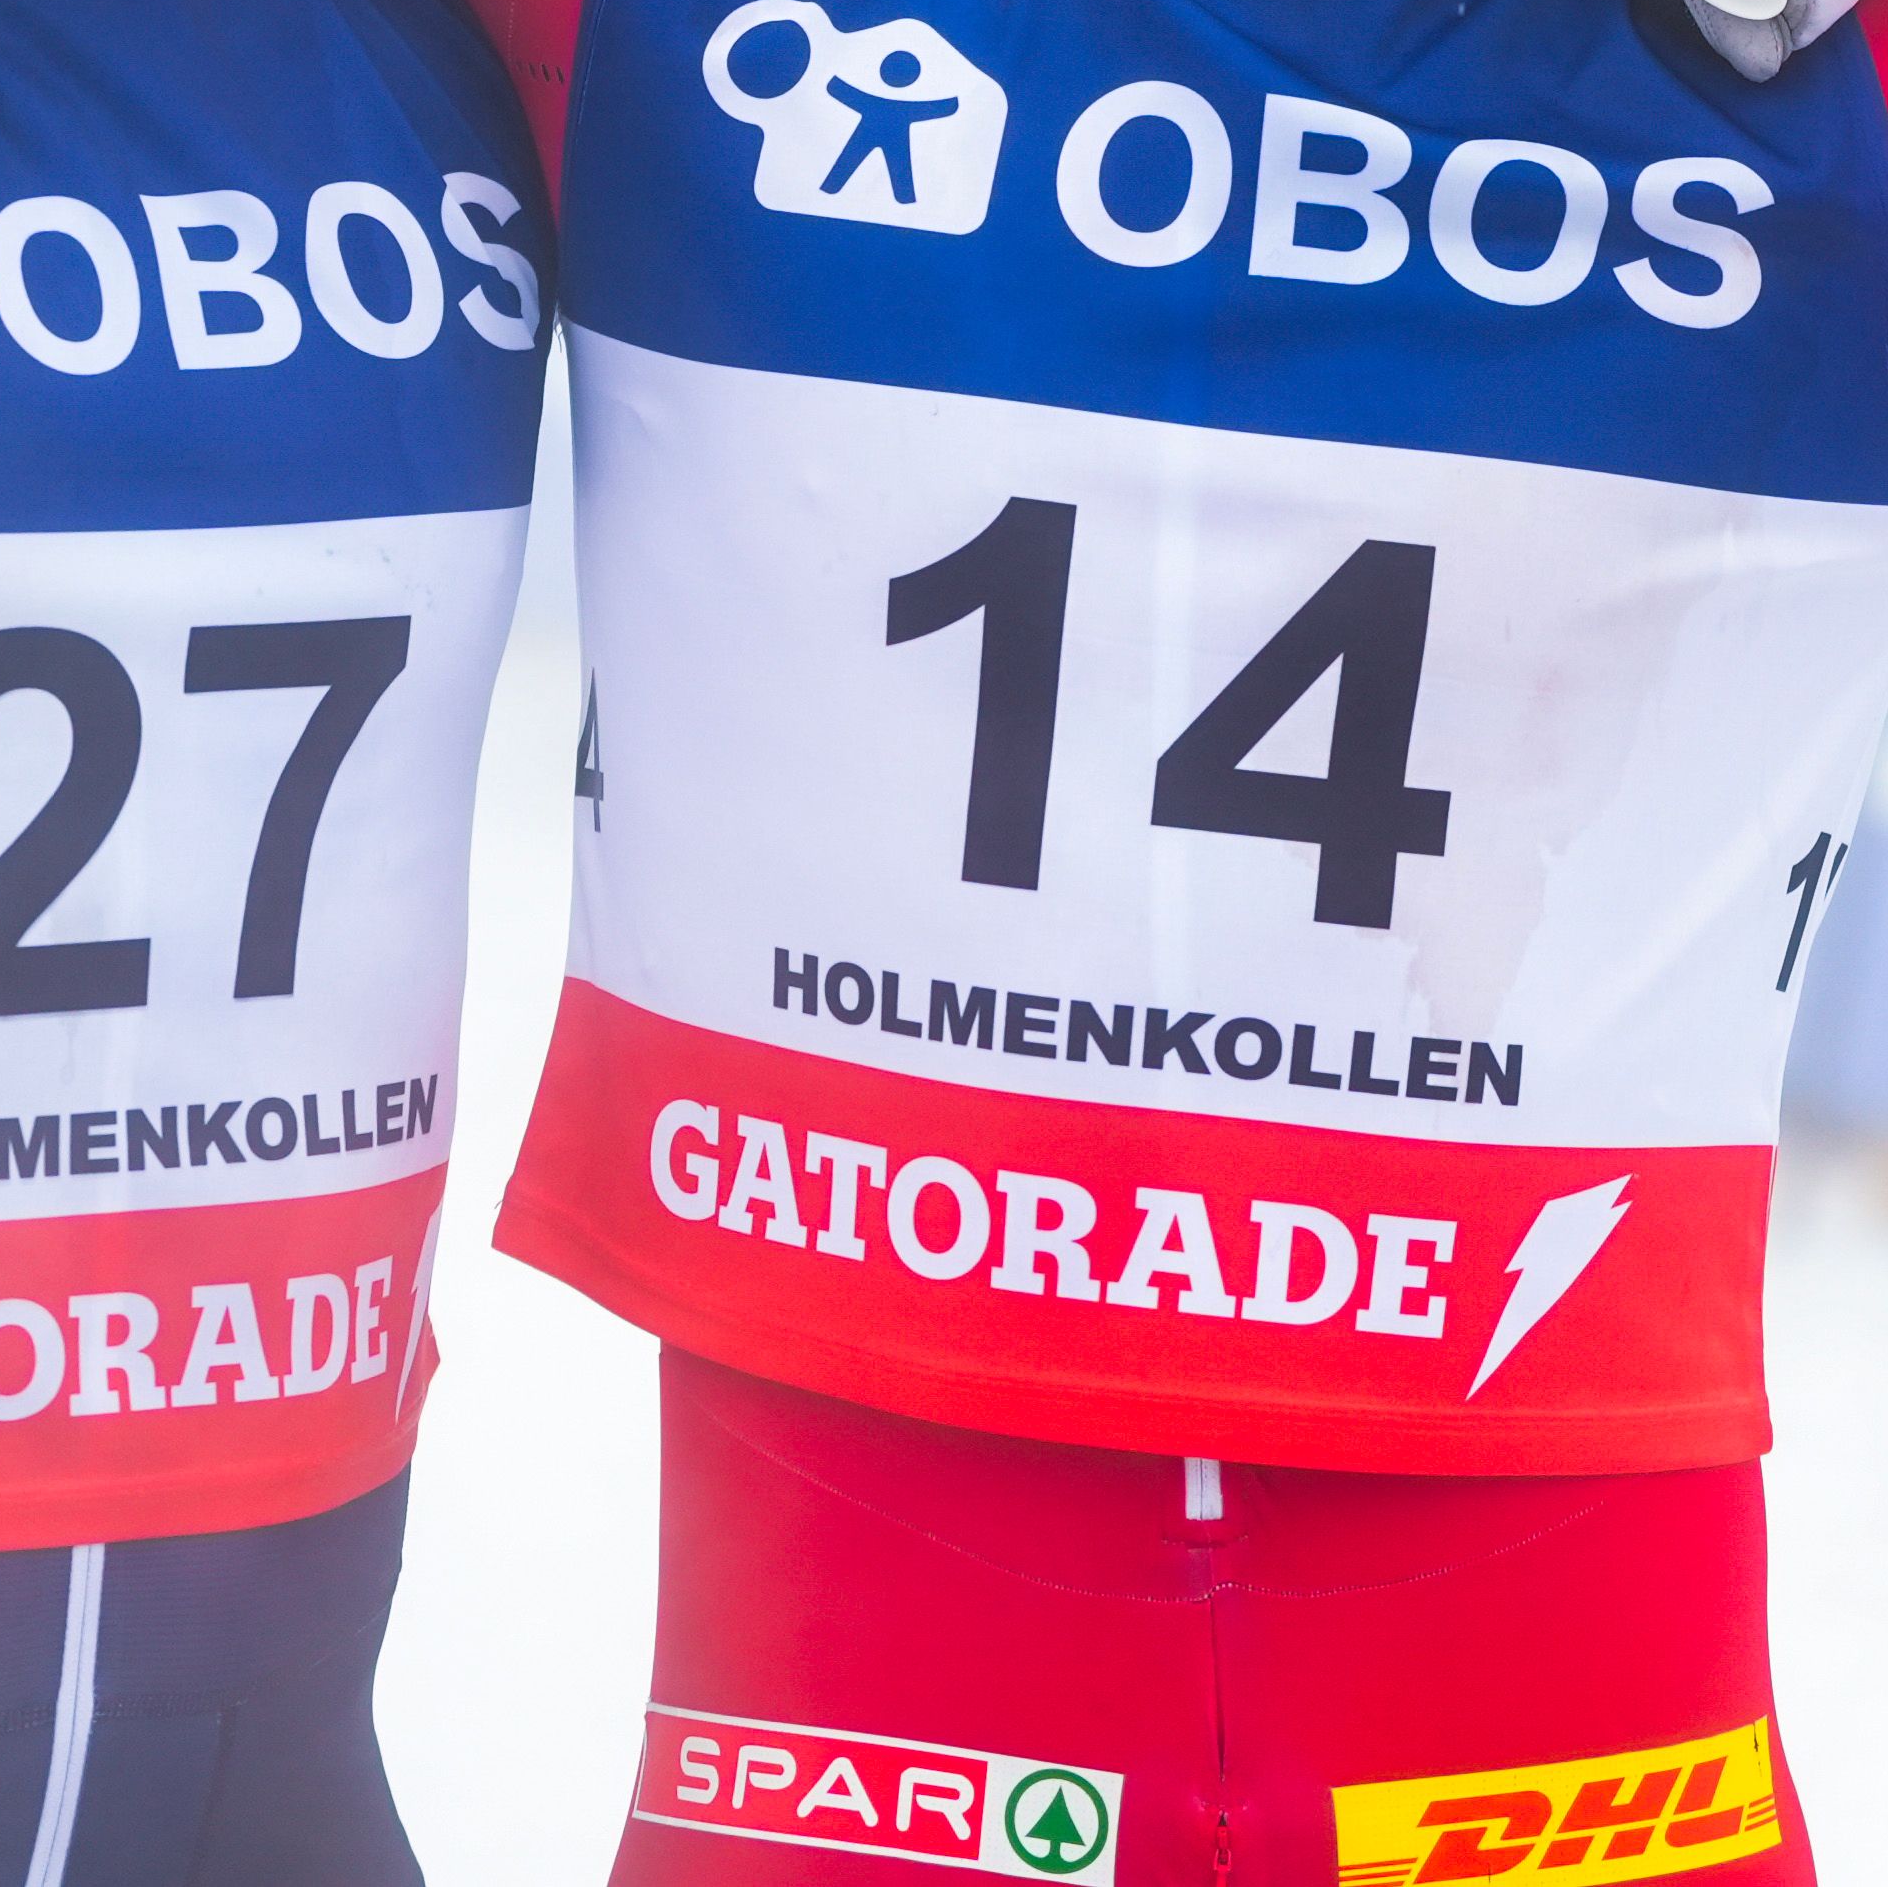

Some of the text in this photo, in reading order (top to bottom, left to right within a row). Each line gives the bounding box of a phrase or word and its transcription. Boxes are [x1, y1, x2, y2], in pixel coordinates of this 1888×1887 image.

[1056, 80, 1776, 330] OBOS
[575, 667, 604, 833] 4
[885, 495, 1451, 930] 14
[1776, 831, 1848, 992] 1
[771, 949, 1524, 1107] HOLMENKOLLEN
[649, 1100, 1458, 1339] GATORADE
[676, 1736, 975, 1841] SPAR
[1414, 1756, 1744, 1884] DHL
